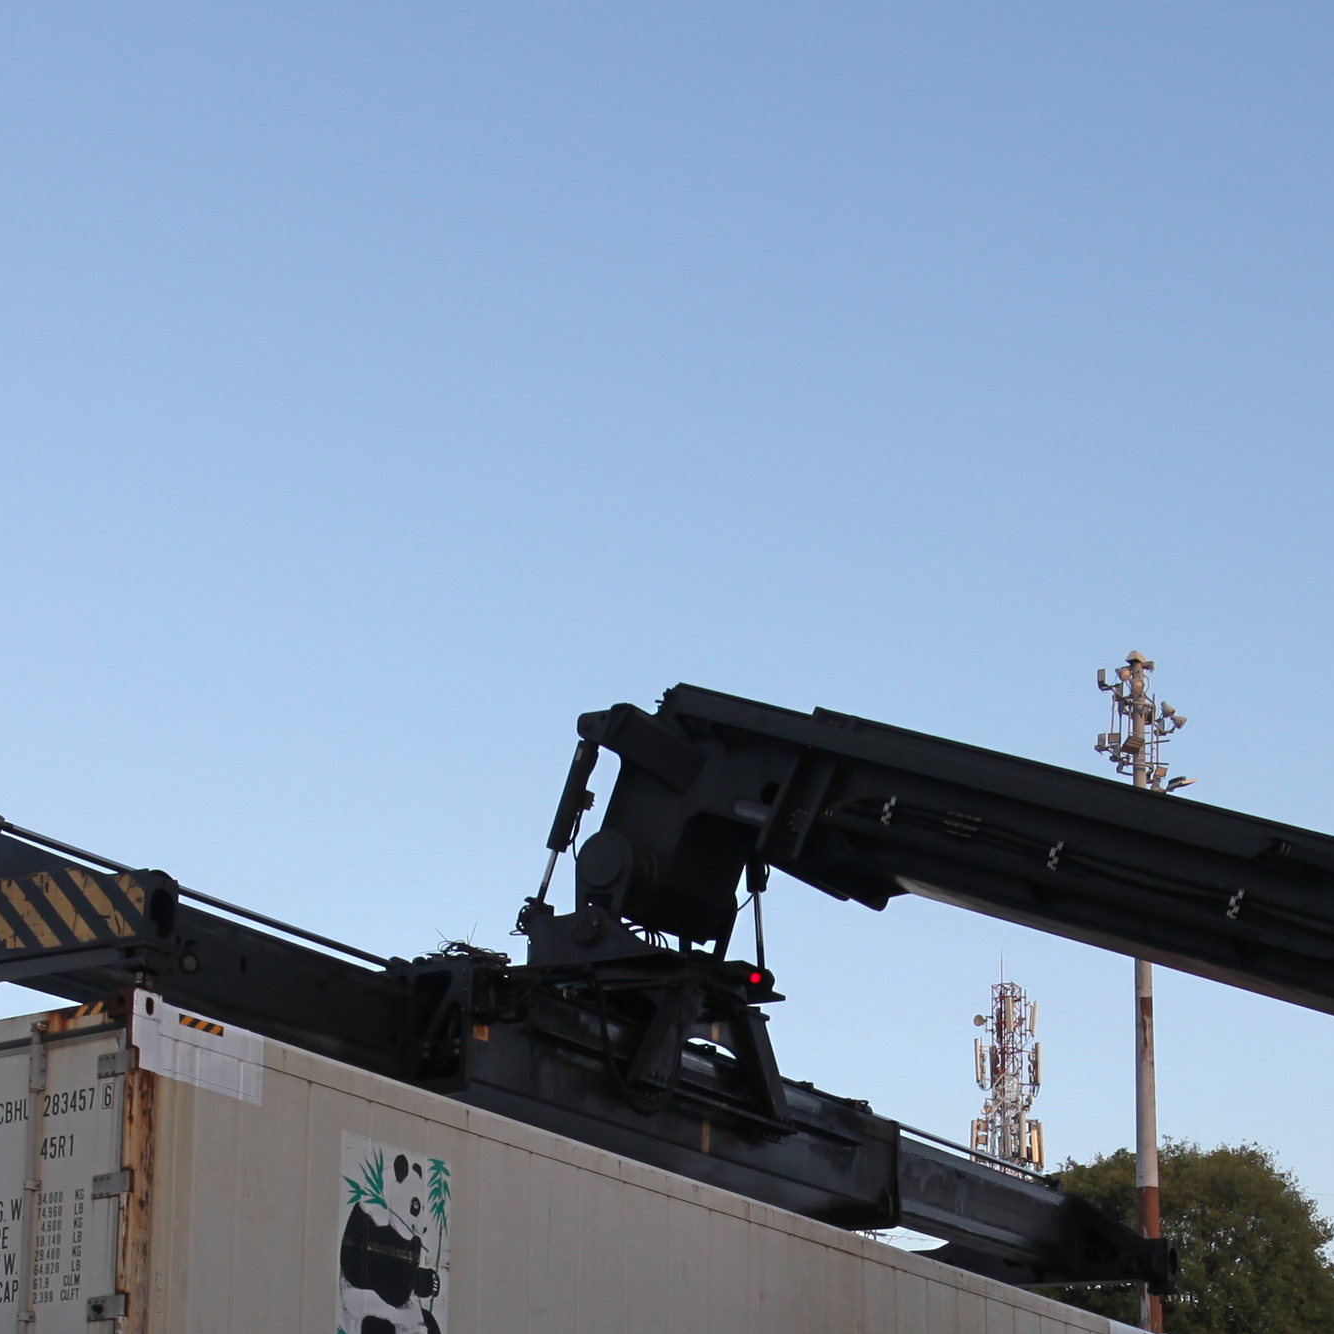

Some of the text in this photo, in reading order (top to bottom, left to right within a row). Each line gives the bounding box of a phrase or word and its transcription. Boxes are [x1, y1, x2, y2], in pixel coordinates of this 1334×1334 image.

[43, 1087, 96, 1118] 283457
[104, 1085, 112, 1108] 6
[40, 1134, 75, 1160] 45R1
[74, 1188, 85, 1201] KG
[73, 1203, 84, 1215] LB
[73, 1217, 83, 1230] KG
[72, 1230, 82, 1244] LB
[71, 1245, 82, 1258] KG
[71, 1259, 81, 1272] LB
